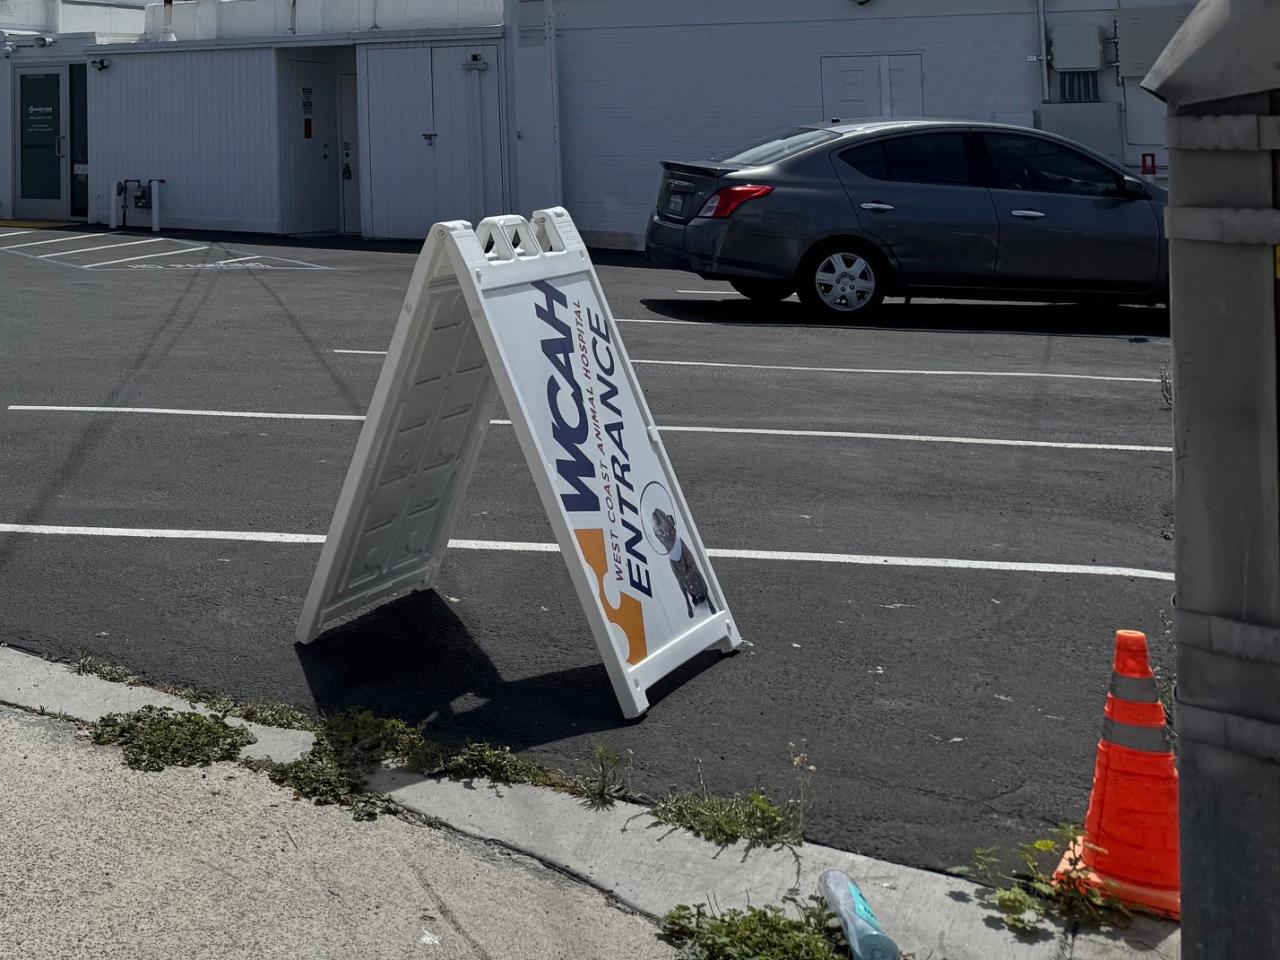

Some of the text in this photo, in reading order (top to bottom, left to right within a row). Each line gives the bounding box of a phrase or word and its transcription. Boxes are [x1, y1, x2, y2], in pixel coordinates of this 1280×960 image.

[531, 280, 600, 511] WCAH
[573, 300, 624, 582] WEST COAST ANIMAL HOSPITAL
[587, 307, 652, 598] ENTRANCE
